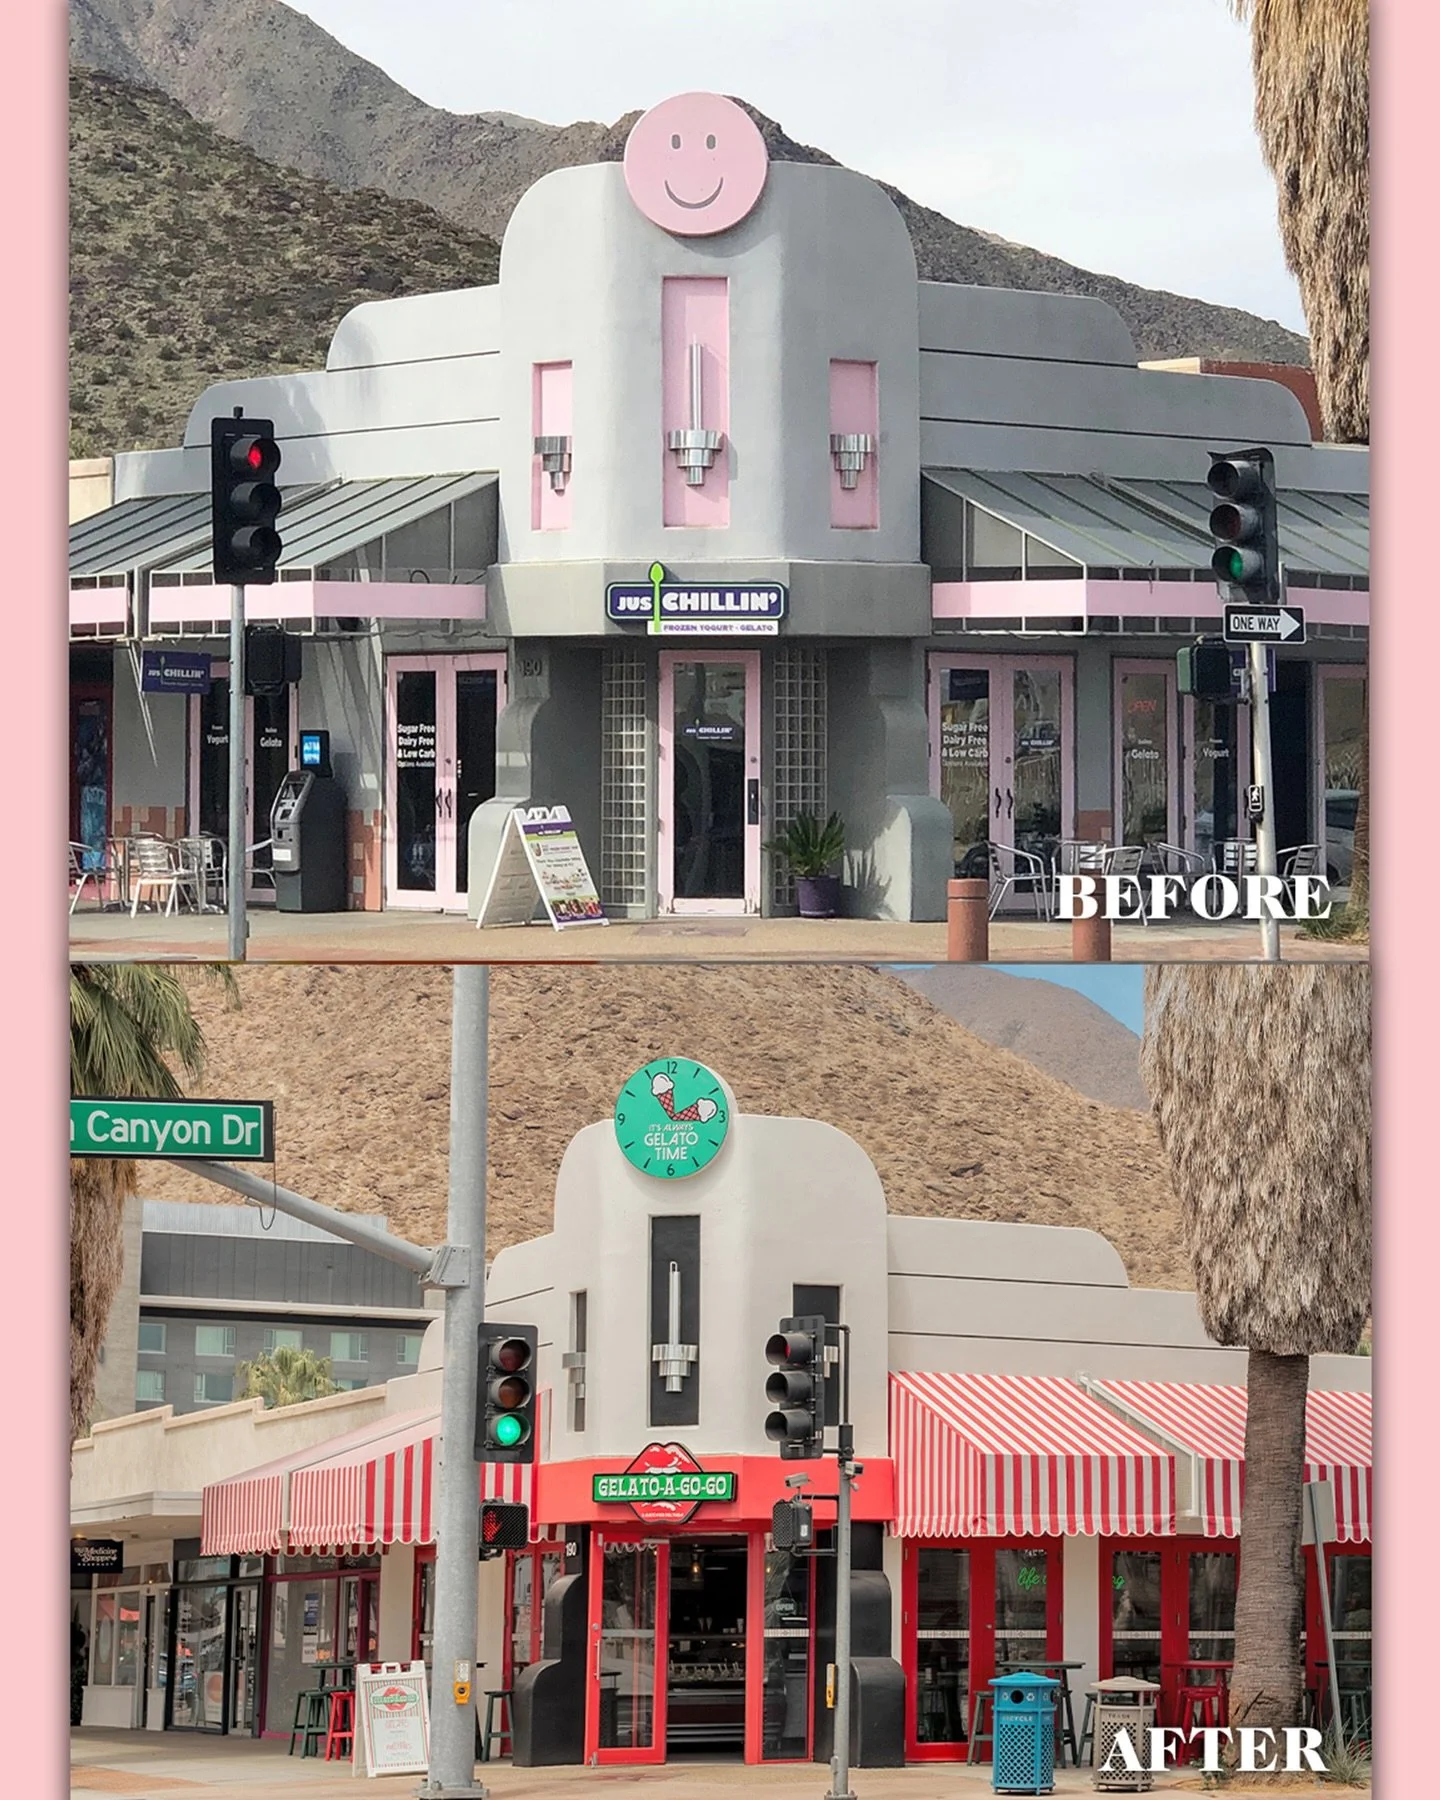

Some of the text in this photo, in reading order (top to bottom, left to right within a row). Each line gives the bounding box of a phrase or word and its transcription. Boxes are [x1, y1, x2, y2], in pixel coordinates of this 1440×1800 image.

[617, 592, 778, 612] JUS CHILLIN'
[663, 624, 774, 632] FROZEN YOGURT GELATO
[1232, 616, 1281, 631] ONE WAY
[419, 723, 436, 733] Free
[942, 722, 988, 733] Sugar Free
[419, 736, 435, 746] Free
[943, 735, 987, 746] Dairy Free
[949, 748, 966, 757] Low
[968, 748, 988, 758] Carb
[1131, 749, 1159, 759] Gelato
[1202, 748, 1230, 759] Yogurt
[667, 1061, 678, 1074] 12
[617, 1112, 626, 1126] 9
[718, 1110, 726, 1123] 3
[87, 1110, 211, 1151] Canyon
[222, 1114, 259, 1146] Dr
[643, 1131, 698, 1147] GELATO
[655, 1146, 689, 1161] TIME
[665, 1163, 676, 1177] 6
[597, 1475, 728, 1497] GELATO-A-GO-GO
